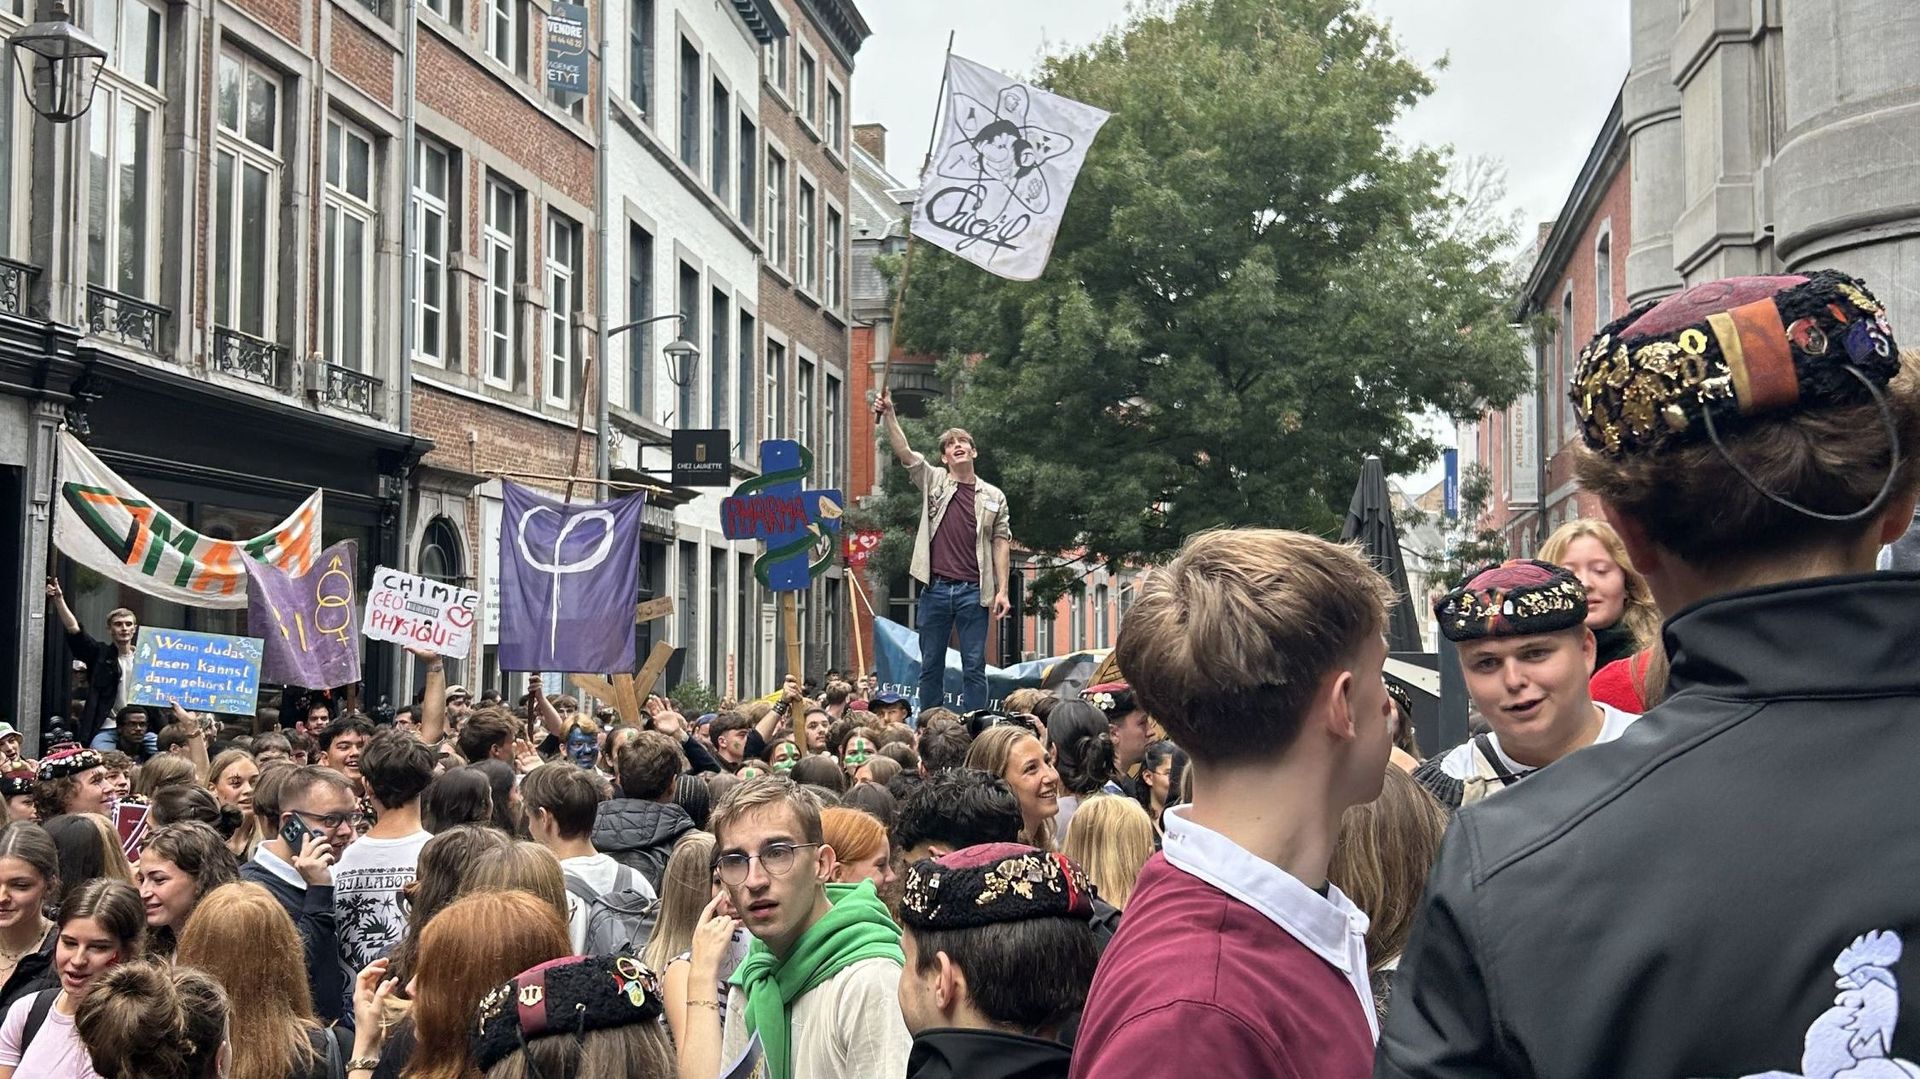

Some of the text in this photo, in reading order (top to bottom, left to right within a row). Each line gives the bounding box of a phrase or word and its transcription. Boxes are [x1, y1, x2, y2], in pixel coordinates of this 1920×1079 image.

[547, 69, 580, 85] ETYT
[726, 496, 808, 537] PHARMA
[155, 635, 199, 653] Wenn
[151, 654, 190, 670] lesen
[145, 671, 178, 685] dann
[236, 682, 253, 694] du
